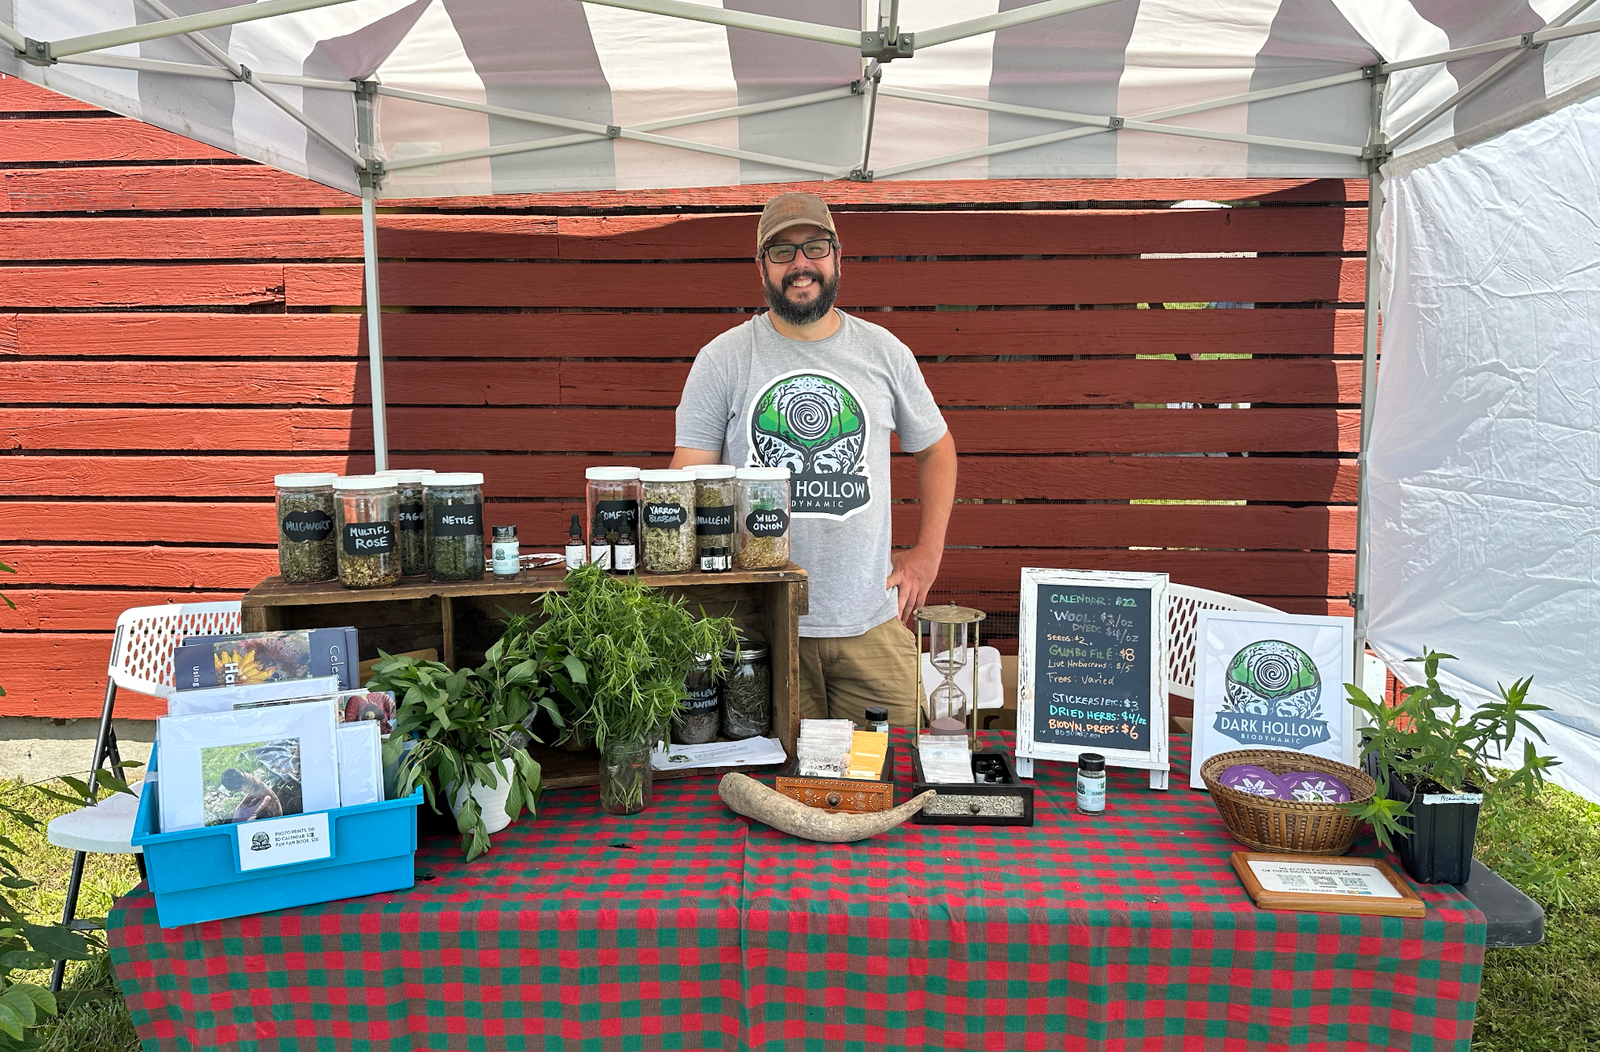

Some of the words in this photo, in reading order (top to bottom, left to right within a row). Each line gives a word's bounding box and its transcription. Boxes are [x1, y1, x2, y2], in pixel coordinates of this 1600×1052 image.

[796, 480, 865, 499] HOLLOW
[791, 500, 844, 508] DYNAMIC
[600, 508, 636, 521] OMFEY
[650, 506, 680, 515] YARROW
[441, 515, 475, 526] NETTLE
[649, 514, 681, 523] BLOSSOM
[755, 514, 778, 523] WILD
[753, 521, 783, 531] ONION
[355, 537, 389, 549] ROSE
[1115, 596, 1137, 607] $22
[1049, 644, 1087, 658] GUMBO
[1047, 659, 1065, 668] Live
[192, 665, 200, 687] Using
[1123, 698, 1139, 712] $3
[1049, 705, 1084, 718] DRIED
[1121, 723, 1139, 740] $6
[1221, 717, 1258, 733] DARK
[1262, 720, 1323, 738] HOLLOW
[1241, 733, 1301, 744] BIODYNAMIC
